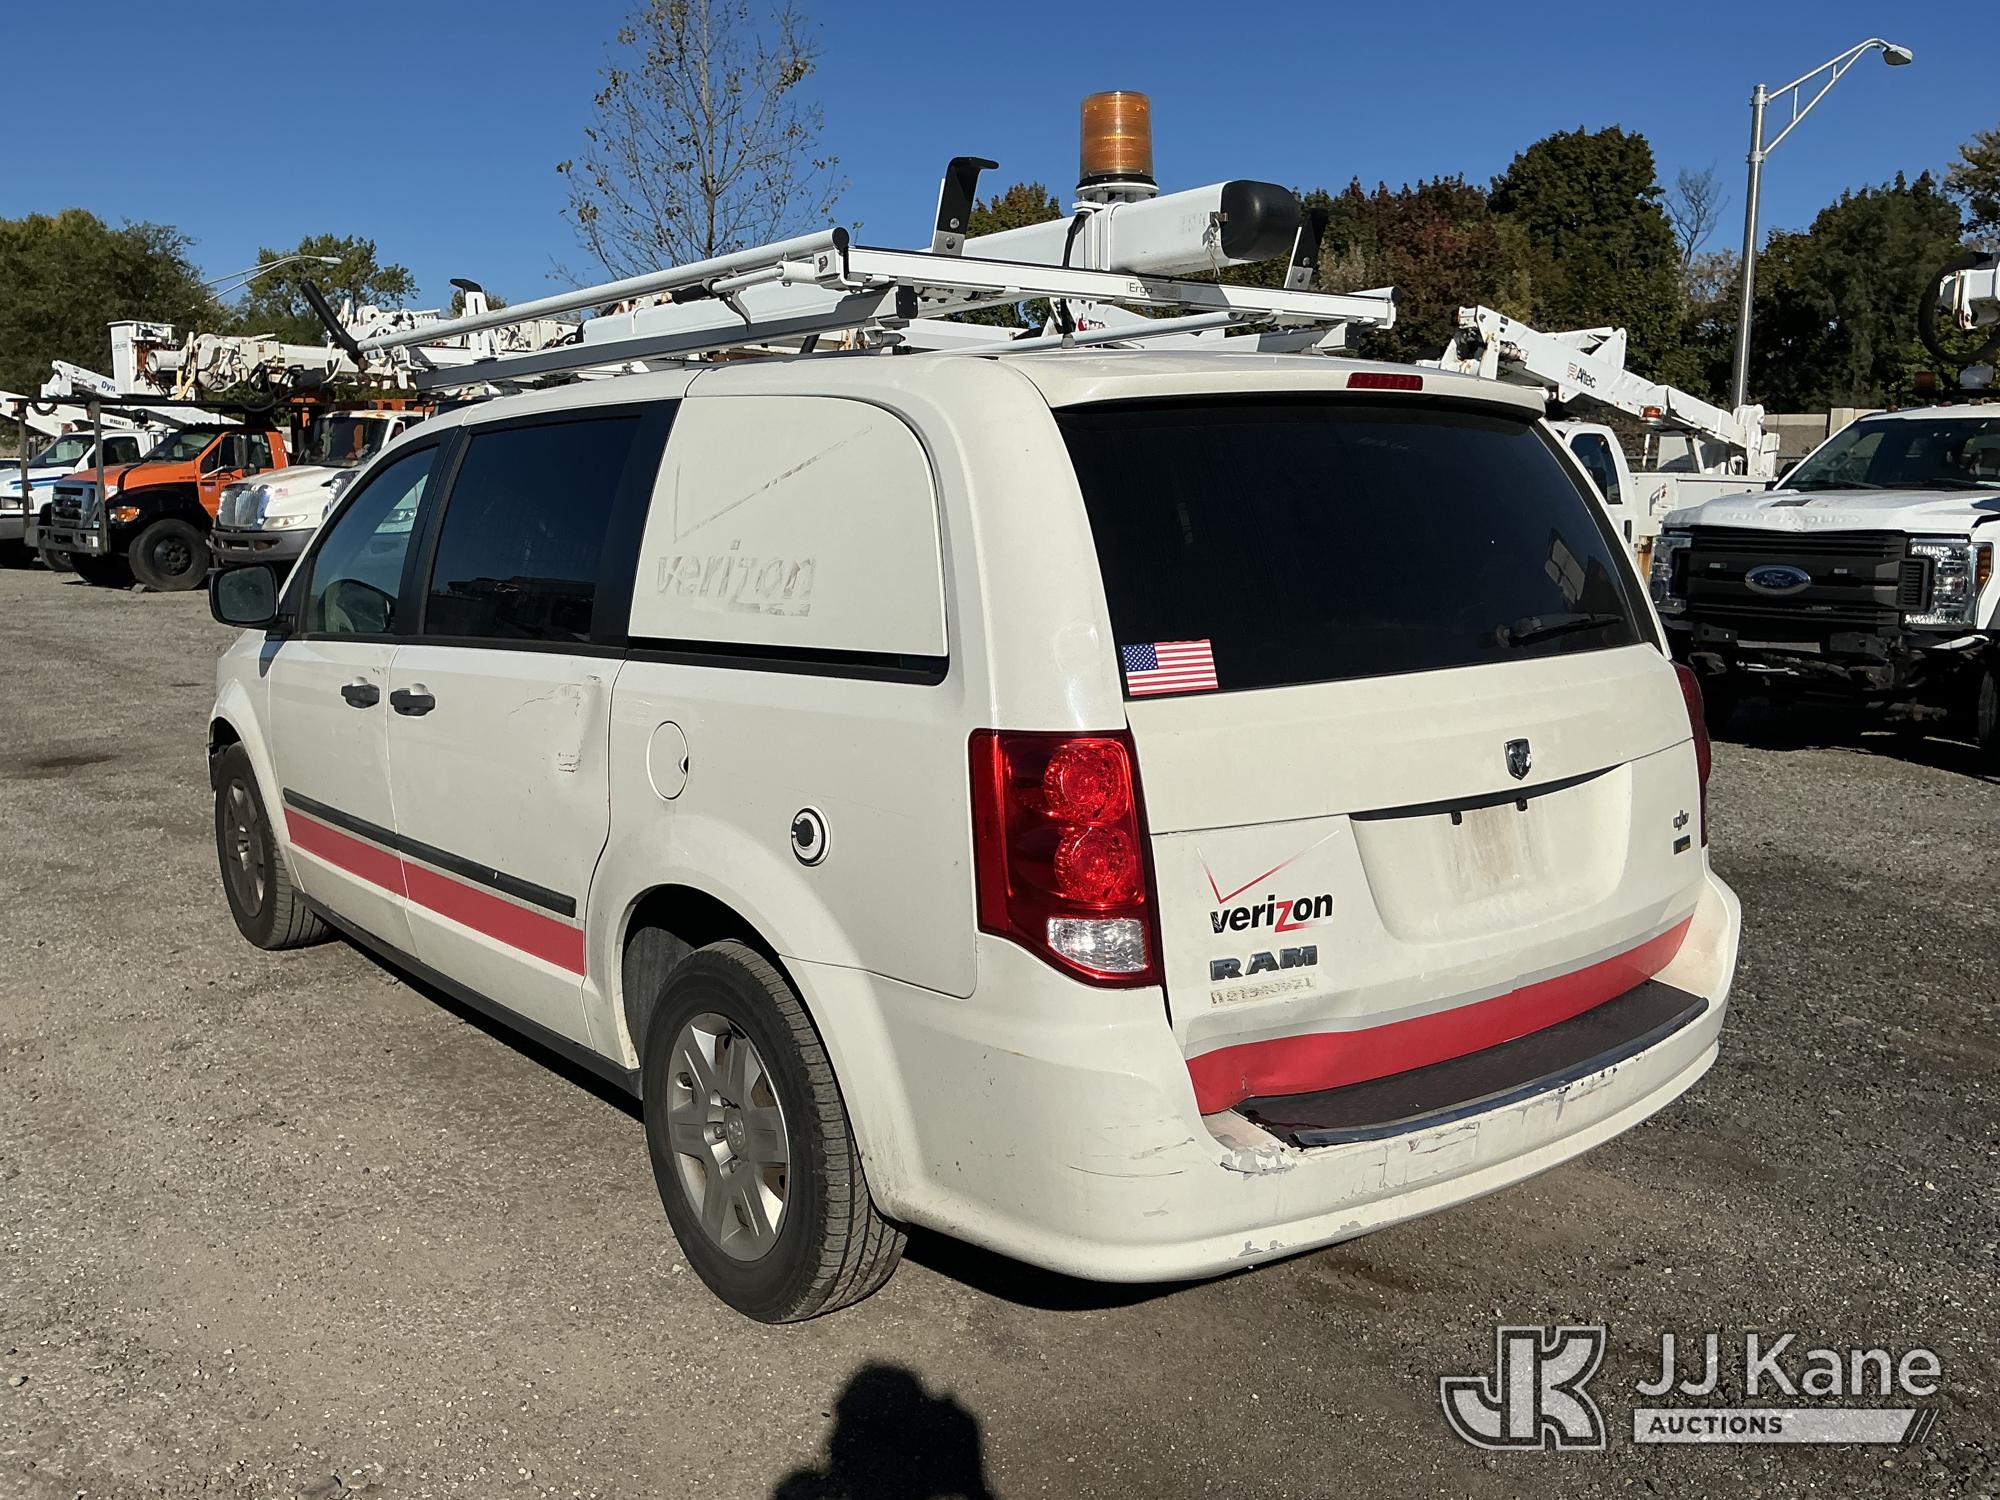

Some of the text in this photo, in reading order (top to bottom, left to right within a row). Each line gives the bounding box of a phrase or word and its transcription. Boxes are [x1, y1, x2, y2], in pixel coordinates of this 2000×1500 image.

[1576, 367, 1597, 389] Altec
[657, 538, 815, 617] verizon
[1209, 893, 1334, 934] verizon
[1209, 944, 1318, 982] RAM
